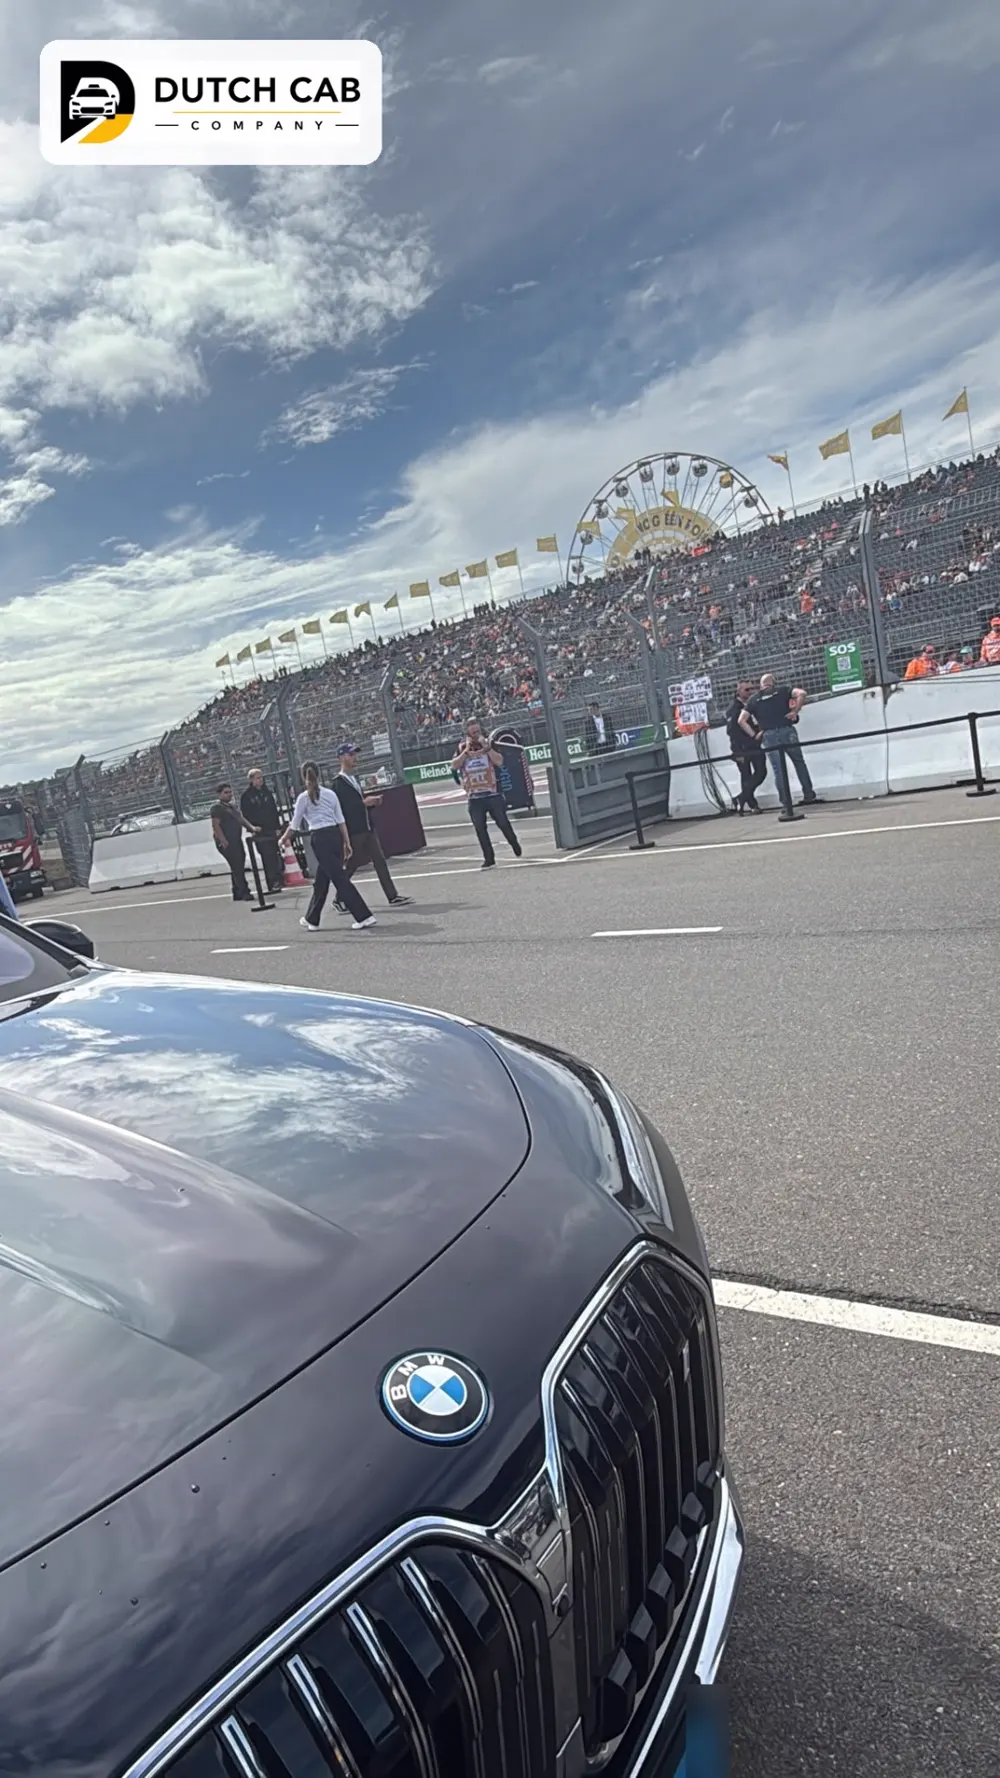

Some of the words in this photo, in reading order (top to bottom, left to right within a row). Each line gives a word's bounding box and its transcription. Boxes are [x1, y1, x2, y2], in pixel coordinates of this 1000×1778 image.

[829, 642, 856, 657] SOS
[420, 763, 452, 779] Heinek
[390, 1354, 446, 1401] BMW
